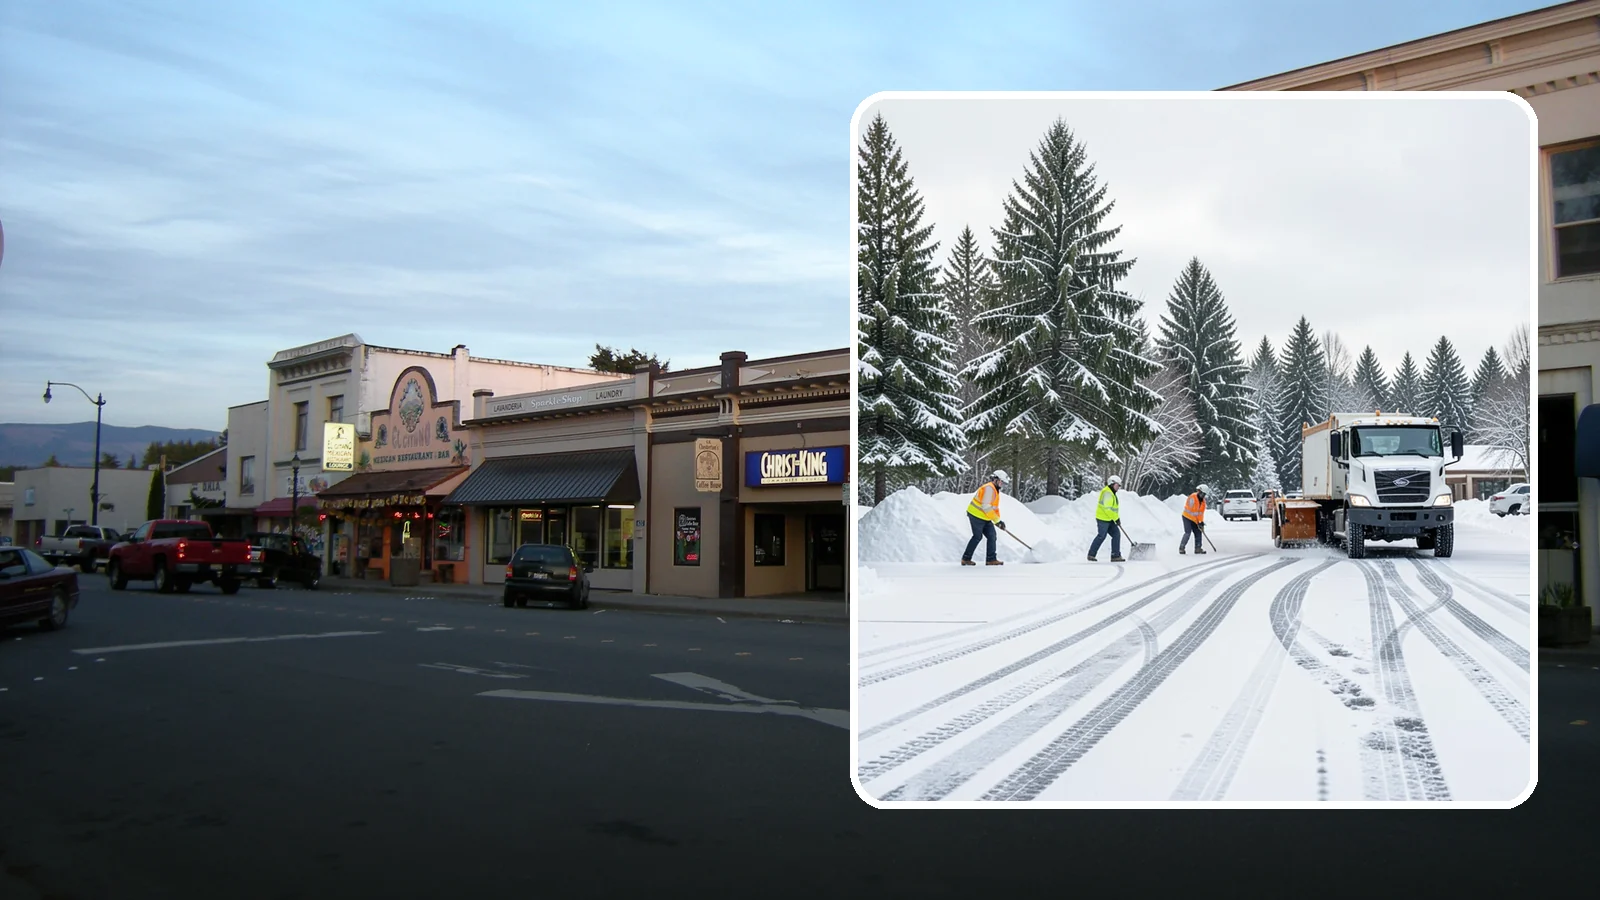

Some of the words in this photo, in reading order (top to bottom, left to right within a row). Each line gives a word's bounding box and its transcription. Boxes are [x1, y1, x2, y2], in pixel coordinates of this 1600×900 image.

[493, 402, 522, 413] LAVANDERIA
[531, 396, 561, 410] Sparkle
[562, 394, 583, 406] Shop
[595, 389, 624, 400] LAUNDRY
[392, 425, 402, 449] EL
[373, 454, 396, 464] MEXICAN
[397, 451, 433, 462] RESTAURANT
[437, 450, 450, 459] BAR
